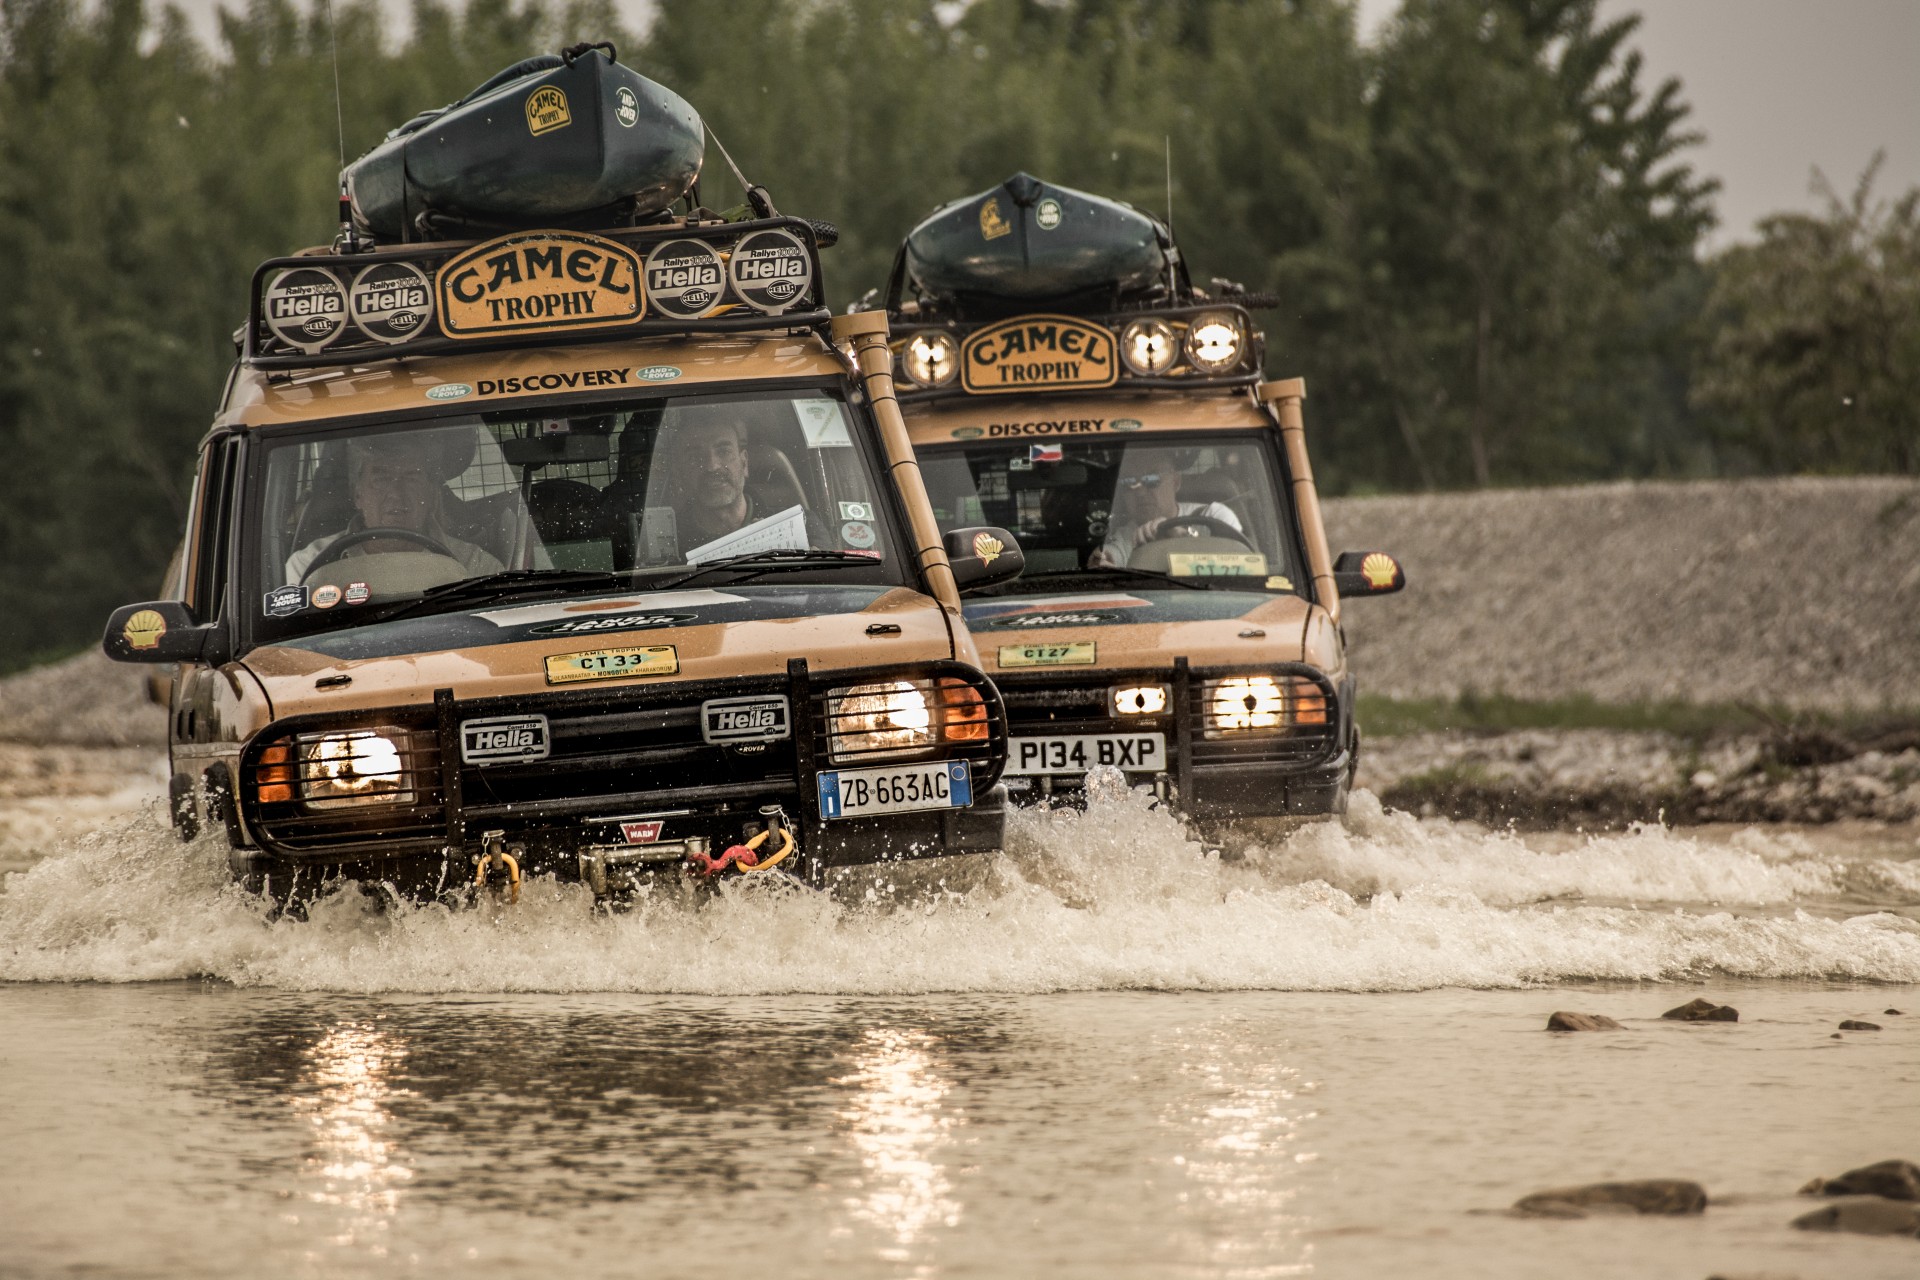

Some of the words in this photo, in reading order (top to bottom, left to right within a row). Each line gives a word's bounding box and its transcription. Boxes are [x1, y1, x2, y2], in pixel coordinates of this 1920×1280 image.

[530, 92, 564, 118] CAMEL
[538, 110, 560, 125] TROPHY
[663, 258, 690, 267] Rallye
[750, 250, 776, 258] Rallye
[452, 246, 630, 304] CAMEL
[654, 267, 717, 289] Hella
[741, 258, 803, 280] Hella
[285, 286, 312, 296] Rallye
[369, 281, 396, 291] Rallye
[768, 284, 796, 294] HELLA
[275, 295, 340, 317] Hella
[361, 289, 424, 313] Hella
[486, 290, 597, 322] TROPHY
[682, 292, 710, 302] HELLA
[305, 321, 333, 331] HELLA
[391, 314, 417, 325] HELLA
[972, 326, 1106, 366] CAMEL
[997, 361, 1081, 382] TROPHY
[477, 368, 631, 396] DISCOVERY
[989, 419, 1104, 437] DISCOVERY
[580, 656, 608, 669] CT
[613, 653, 642, 666] 33
[1024, 649, 1045, 658] CT
[1048, 647, 1070, 657] 27
[717, 711, 776, 730] Hella
[475, 730, 534, 750] Hella
[743, 744, 766, 753] ROVER
[1020, 740, 1088, 769] P134
[1097, 738, 1155, 766] BXP
[841, 779, 869, 808] ZB
[876, 772, 949, 804] 663AG
[630, 830, 654, 838] WARN
